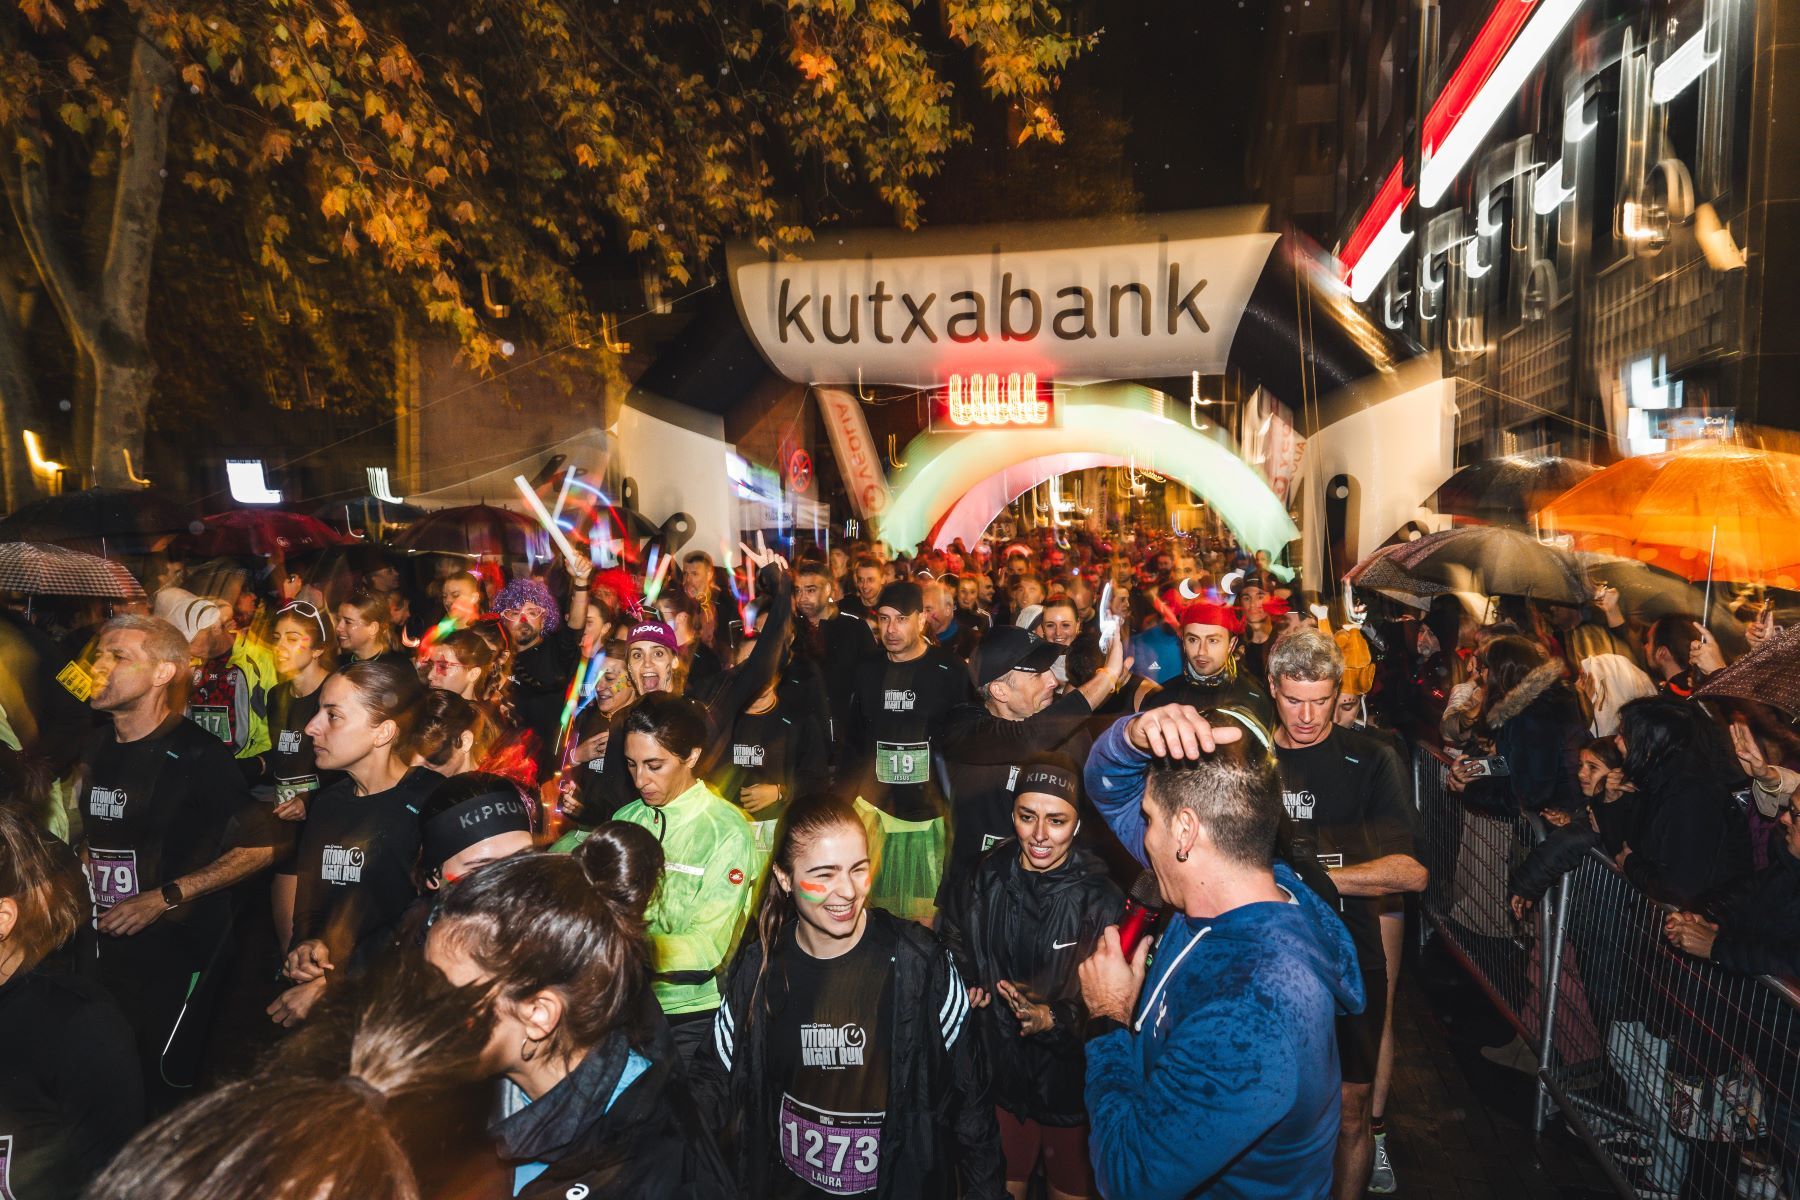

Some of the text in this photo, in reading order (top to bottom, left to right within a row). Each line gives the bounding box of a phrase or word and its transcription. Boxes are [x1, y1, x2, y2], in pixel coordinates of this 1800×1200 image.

[778, 262, 1210, 344] kutxabank
[632, 625, 664, 636] HOKA
[889, 754, 914, 773] 19
[1026, 772, 1076, 792] KIPRUN
[101, 895, 115, 903] LUIS
[800, 1028, 846, 1048] VITORIA
[802, 1047, 864, 1066] NIGHT RUN
[785, 1121, 879, 1173] 1273
[812, 1170, 842, 1188] LAURA
